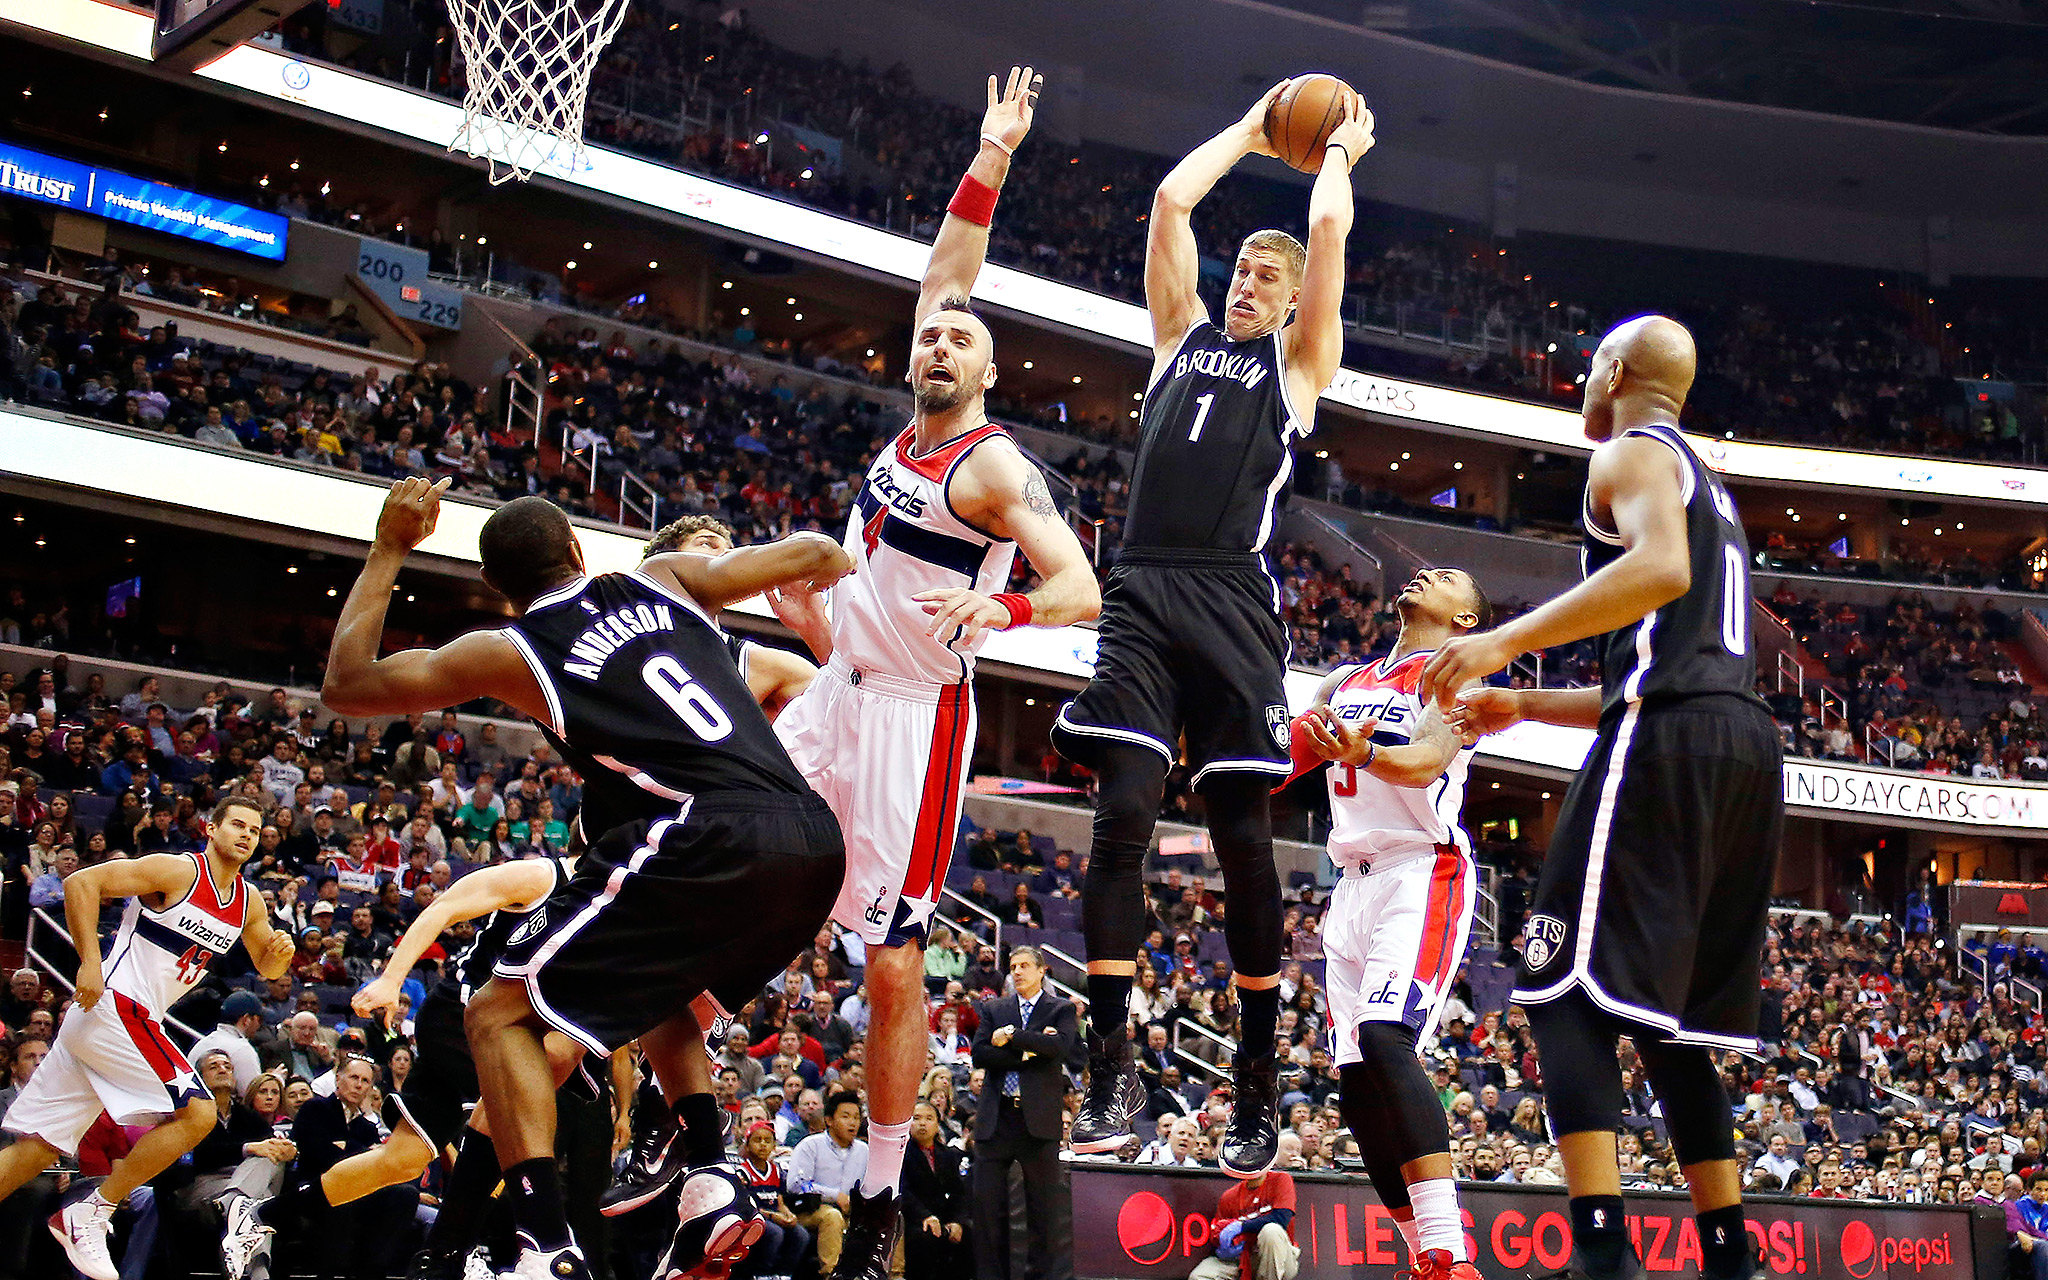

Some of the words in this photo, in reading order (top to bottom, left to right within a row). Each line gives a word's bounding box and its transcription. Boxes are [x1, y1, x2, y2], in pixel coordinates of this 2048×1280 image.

[104, 190, 150, 213] Private
[150, 202, 196, 225] Wealth
[196, 214, 276, 246] Management
[360, 254, 403, 282] 200
[419, 300, 459, 325] 229
[1174, 349, 1270, 391] BROOKLYN
[1187, 392, 1216, 443] 1
[864, 503, 889, 560] 4
[1721, 543, 1746, 657] 0
[562, 603, 675, 681] ANDERSON
[640, 655, 736, 743] 6
[175, 943, 213, 986] 43
[1367, 979, 1399, 1005] dc
[1334, 1203, 1479, 1267] LES
[1490, 1209, 1574, 1271] GO
[1624, 1208, 1808, 1275] IZADS!
[1880, 1231, 1954, 1274] pepsi
